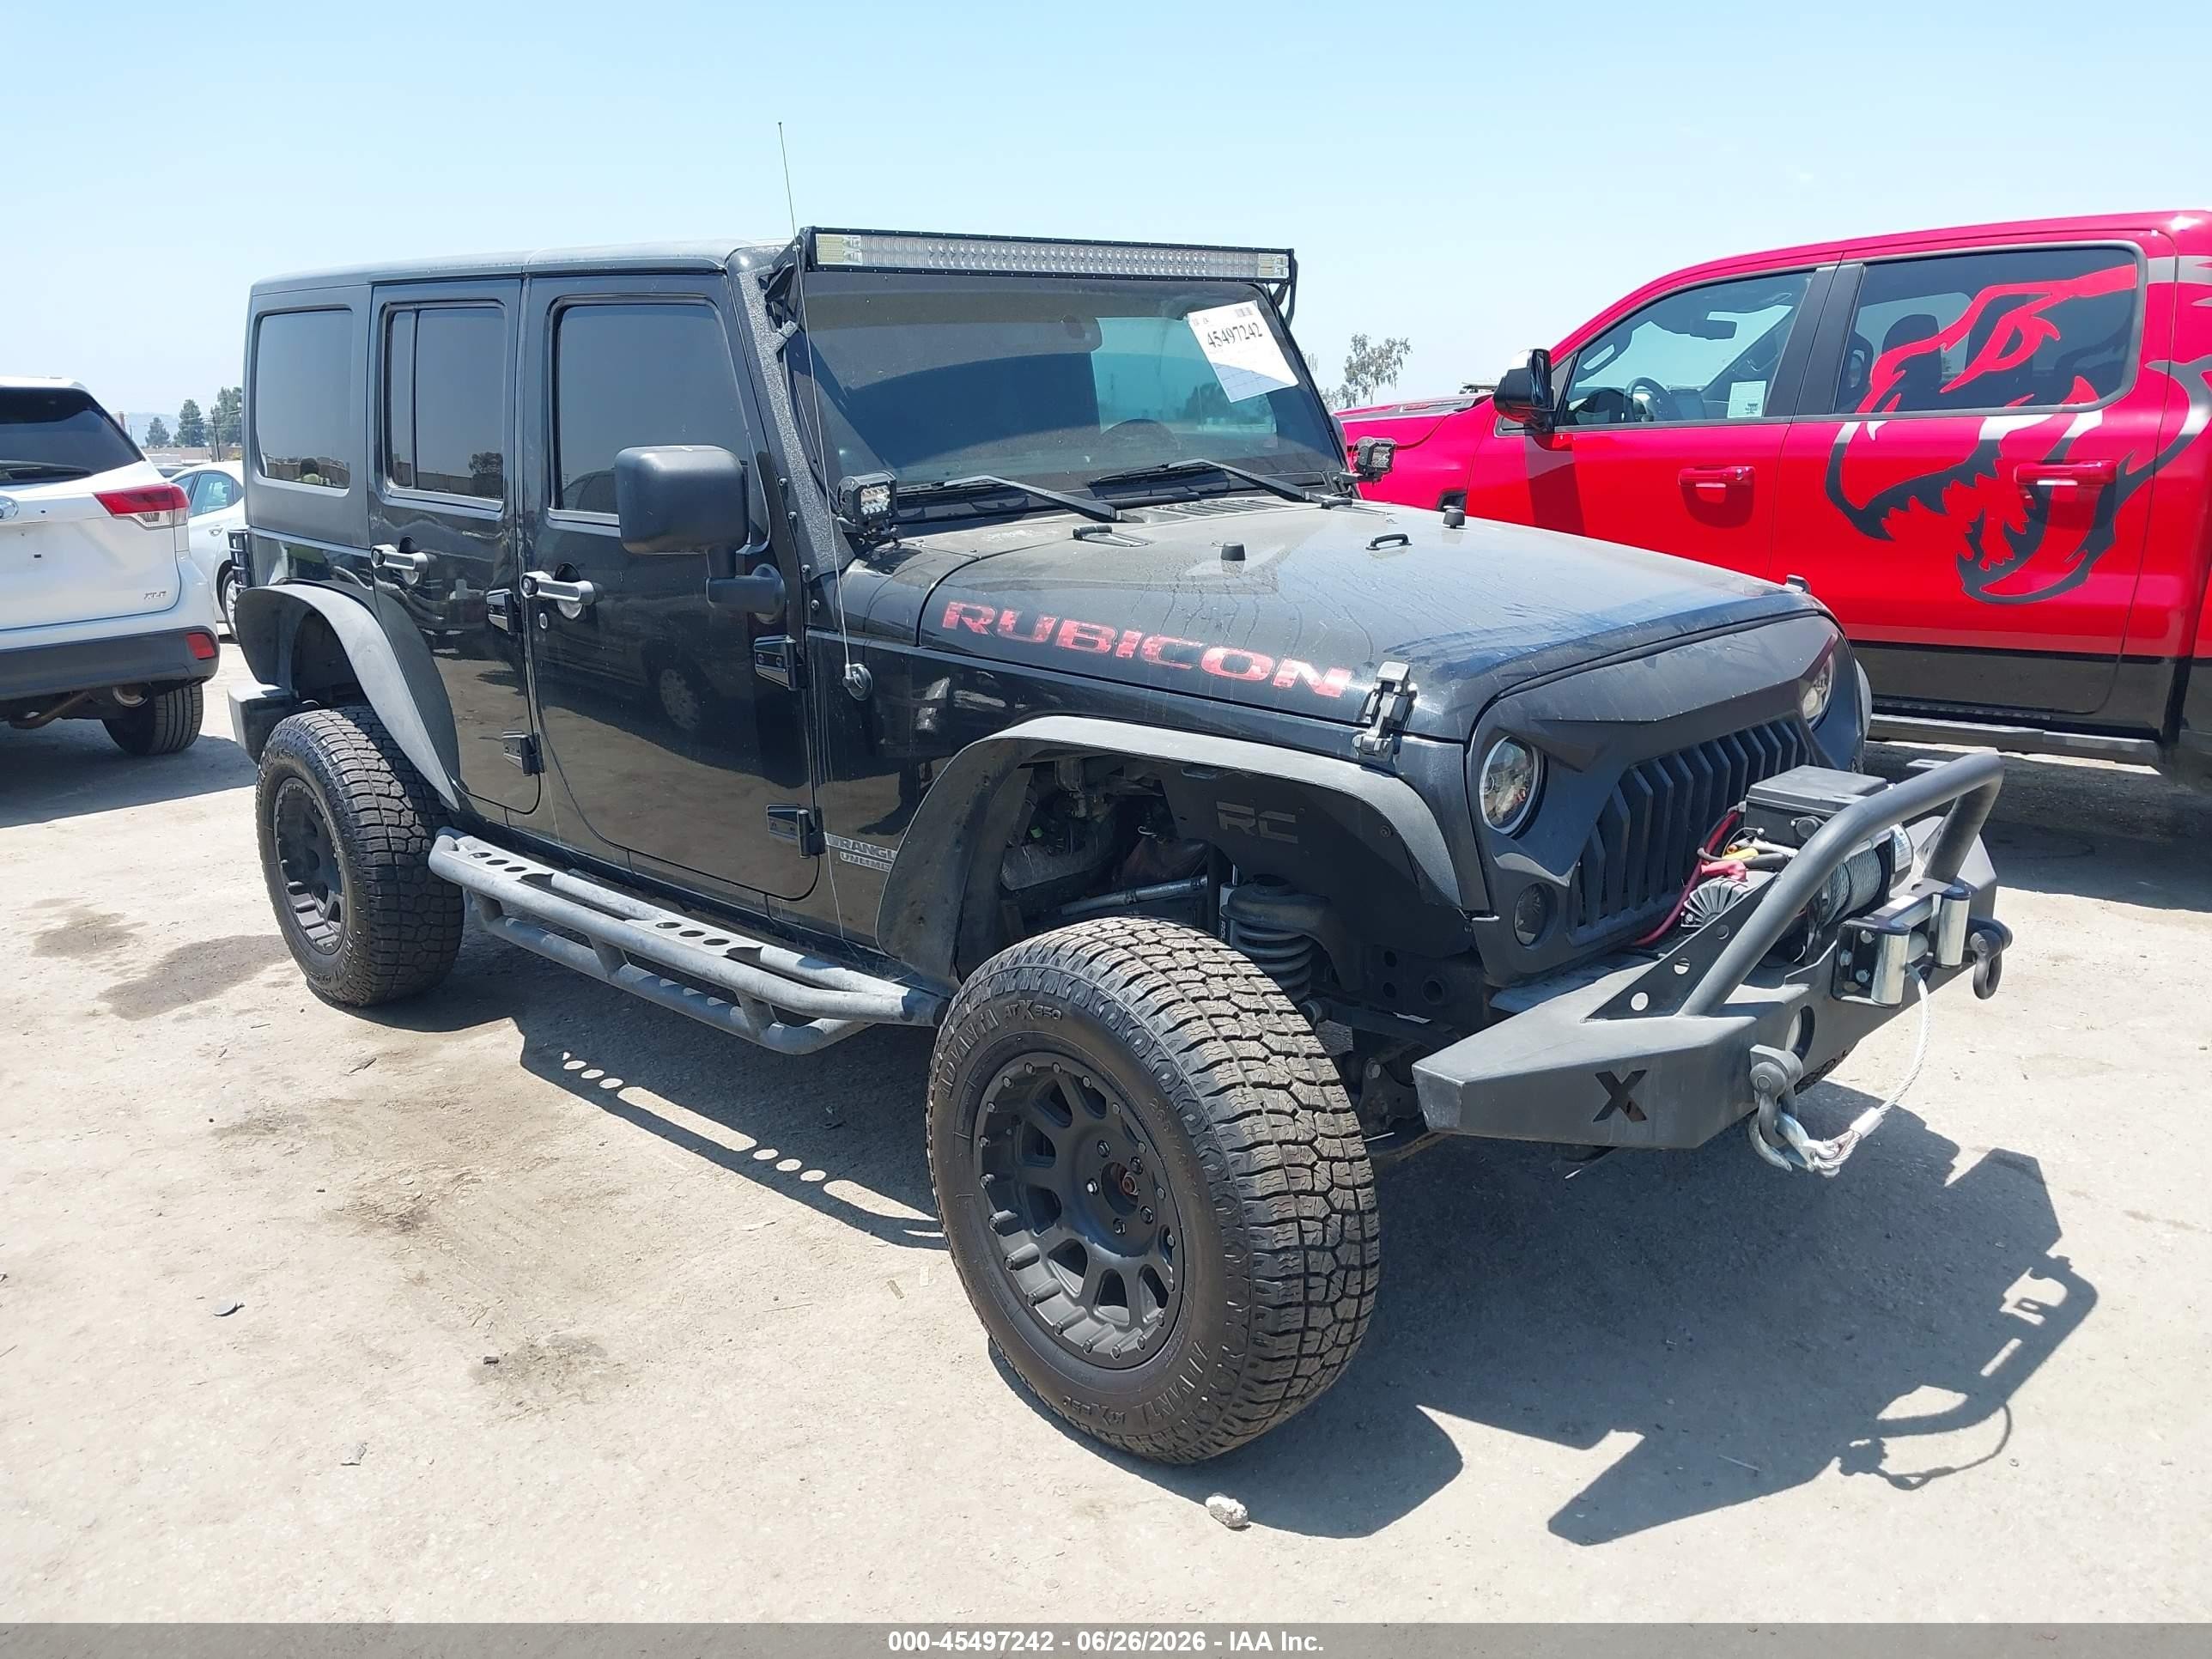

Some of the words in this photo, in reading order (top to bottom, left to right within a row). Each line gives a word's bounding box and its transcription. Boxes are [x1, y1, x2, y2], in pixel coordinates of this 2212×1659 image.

[1207, 323, 1263, 348] 45497242
[942, 601, 1352, 699] RUBICON
[1216, 800, 1298, 844] RC
[1593, 1069, 1648, 1123] X
